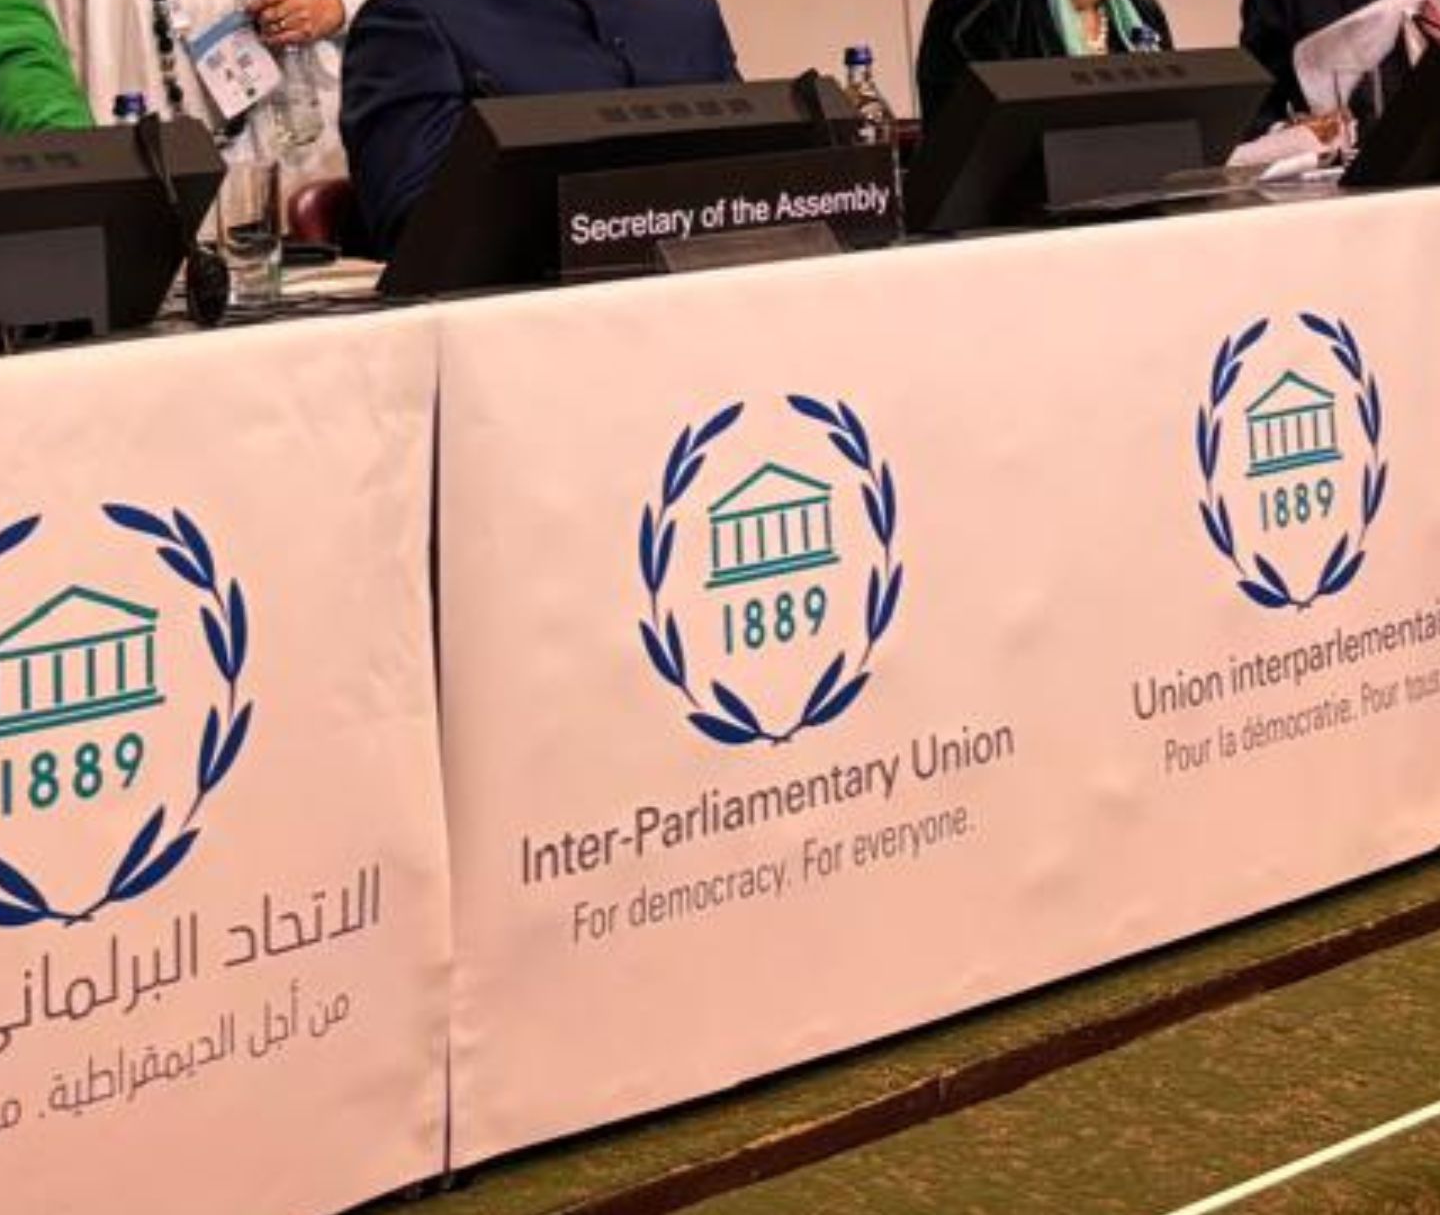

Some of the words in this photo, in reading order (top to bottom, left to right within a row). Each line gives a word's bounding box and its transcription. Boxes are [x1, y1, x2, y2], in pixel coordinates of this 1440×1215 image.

[570, 208, 694, 245] Secretary
[701, 196, 725, 229] of
[731, 195, 770, 226] the
[775, 182, 890, 222] Assembly
[1261, 478, 1335, 530] 1889
[723, 586, 828, 654] 1889
[1133, 665, 1224, 721] Union
[1165, 738, 1212, 775] Pour
[1219, 724, 1236, 758] la
[1361, 680, 1400, 717] Pour
[0, 734, 145, 815] 1889
[521, 752, 900, 885] Inter-Parliamentary
[911, 726, 1016, 780] Union
[572, 901, 617, 944] For
[628, 861, 791, 929] democracy.
[803, 837, 844, 884] For
[854, 804, 976, 868] everyone.
[223, 862, 381, 968] الاتحاد
[248, 978, 300, 1059] أجل
[310, 992, 350, 1038] من
